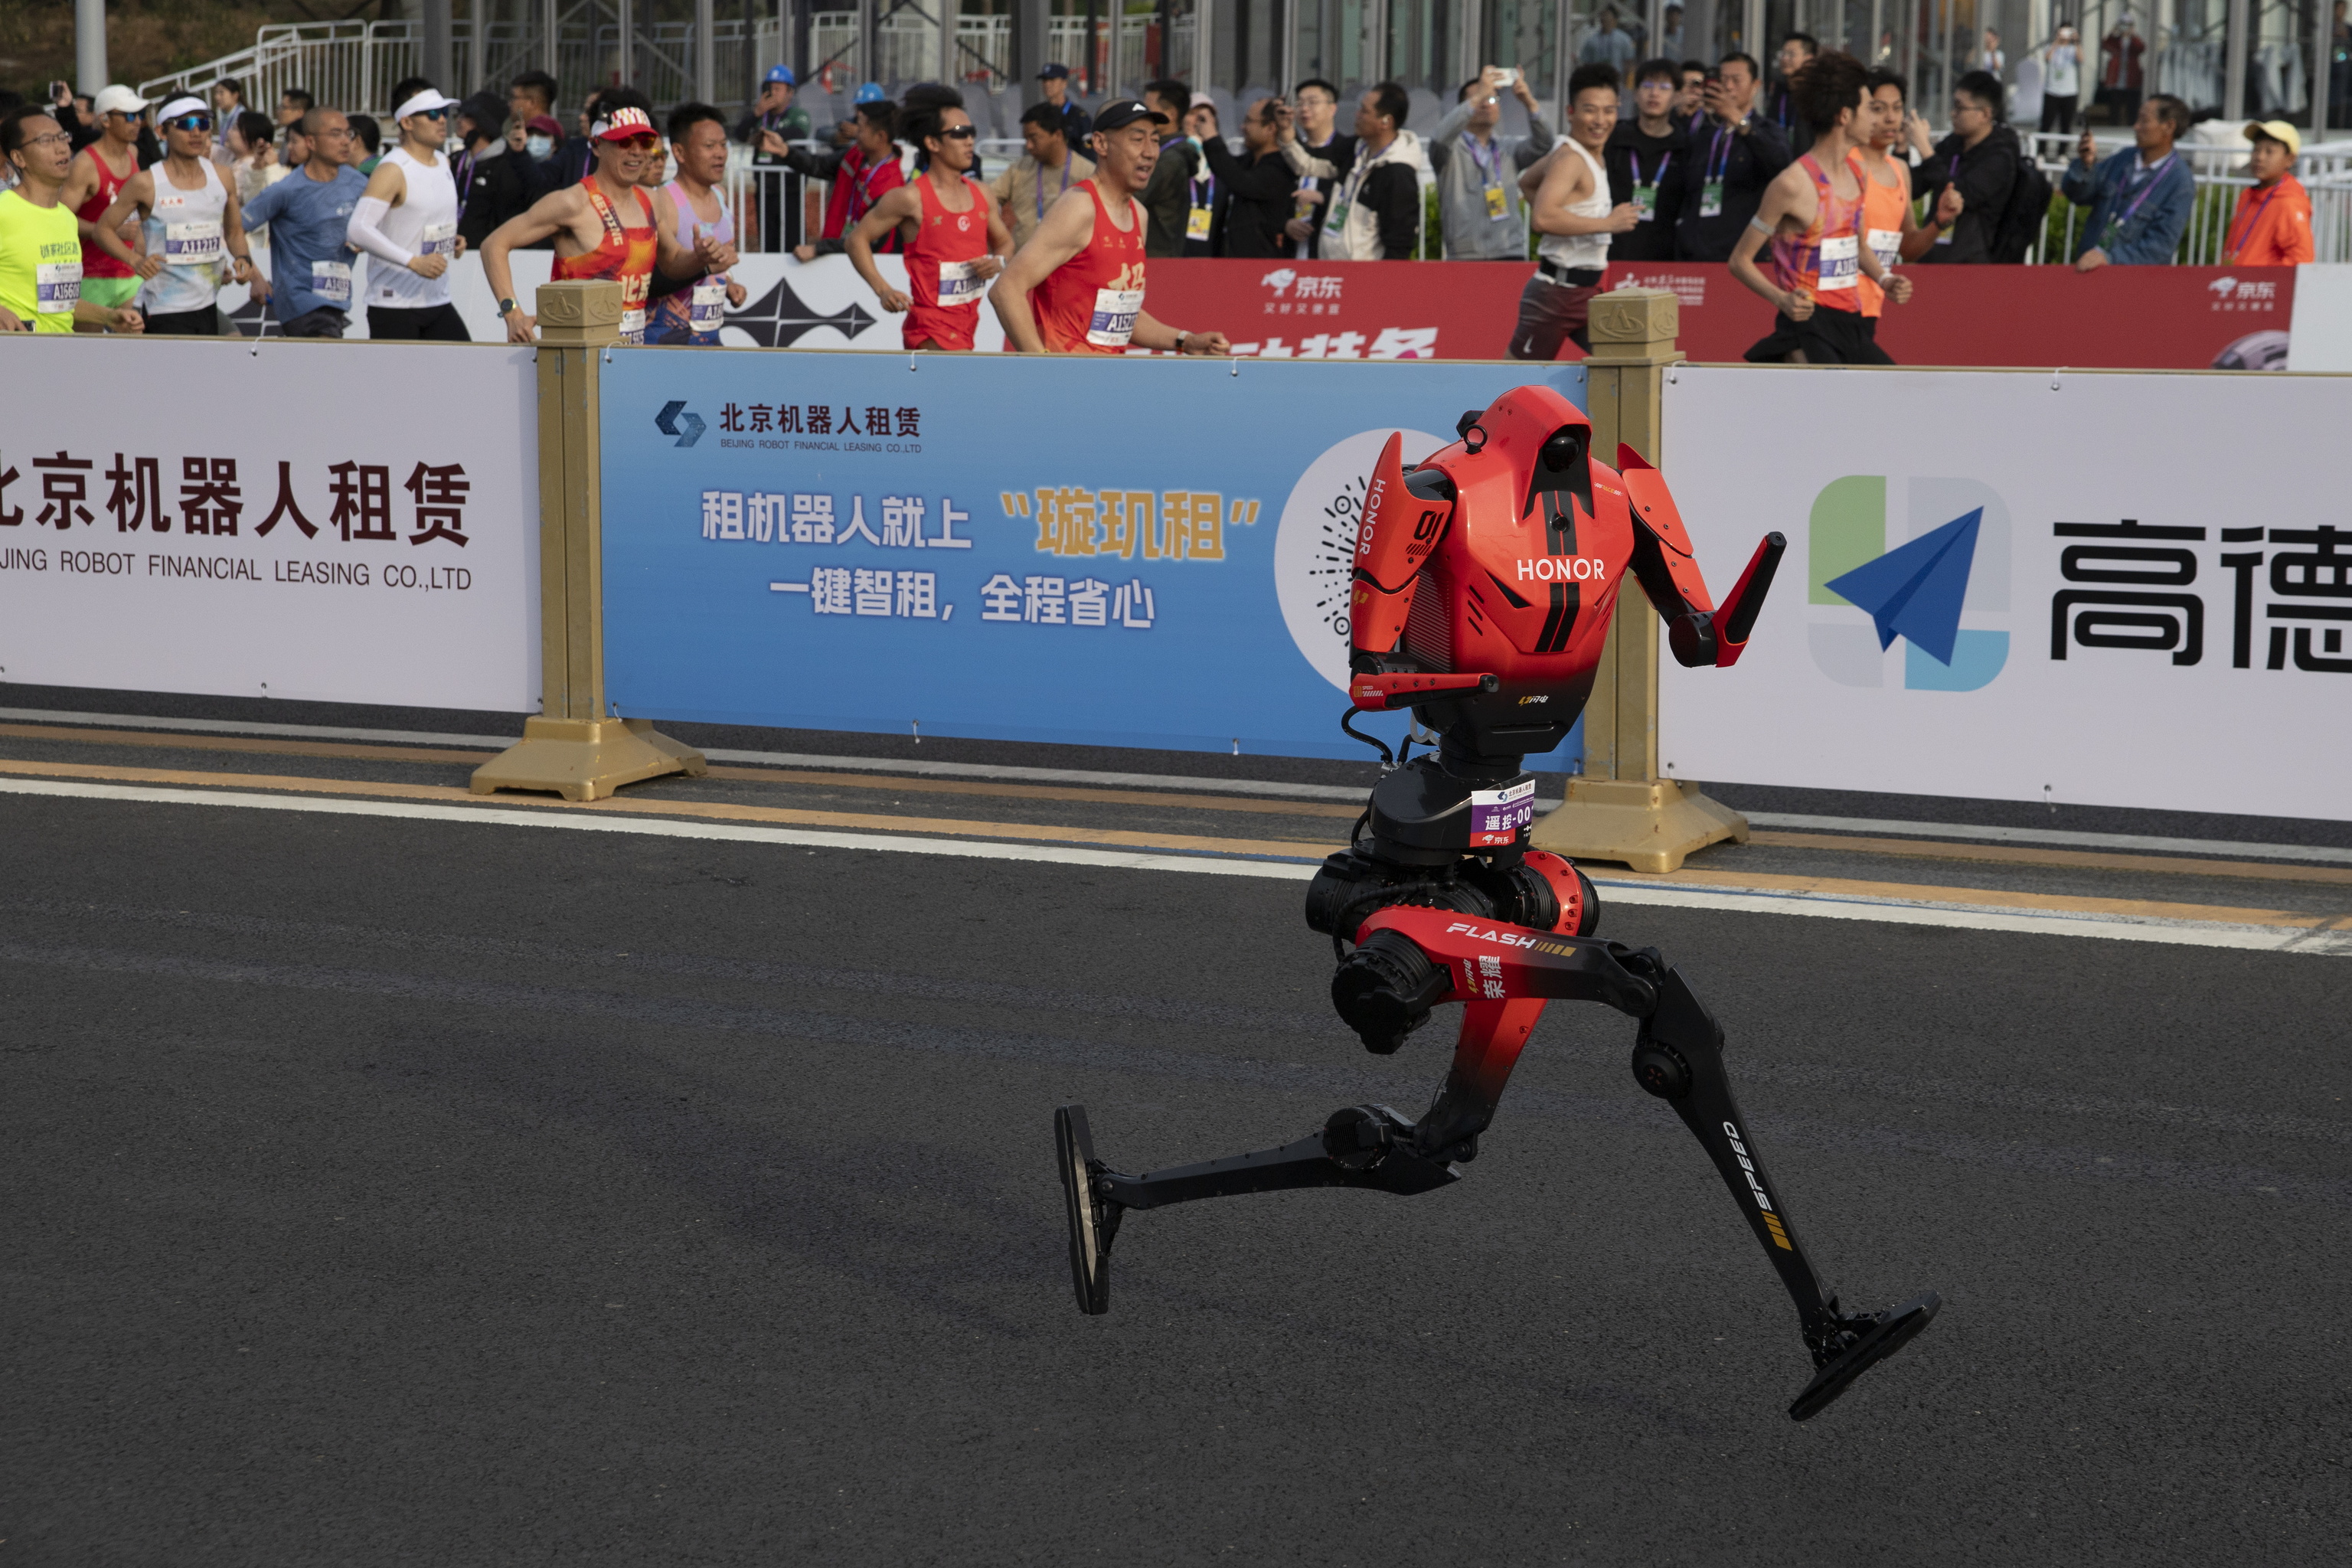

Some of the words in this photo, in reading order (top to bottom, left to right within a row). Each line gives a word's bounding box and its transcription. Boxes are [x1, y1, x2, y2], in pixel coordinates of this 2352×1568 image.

[1295, 276, 1344, 299] 京东
[720, 403, 922, 438] 北京机器人租赁
[720, 439, 754, 449] BEIJING
[759, 440, 790, 450] ROBOT
[794, 441, 840, 452] FINANCIAL
[844, 443, 882, 452] LEASING
[702, 491, 972, 548] 租机器人就上
[1359, 479, 1387, 556] HONOR
[1413, 510, 1445, 541] 01
[60, 550, 136, 575] ROBOT
[149, 554, 262, 581] FINANCIAL
[274, 560, 370, 586] LEASING
[384, 564, 472, 592] CO.,LTD
[1517, 558, 1606, 581] HONOR
[2050, 519, 2352, 674] 高德
[1485, 805, 1534, 831] 遥控-00
[1494, 836, 1509, 844] 京东
[1446, 923, 1537, 949] FLASH
[1478, 955, 1506, 999] 荣耀
[1723, 1121, 1773, 1211] SPEED
